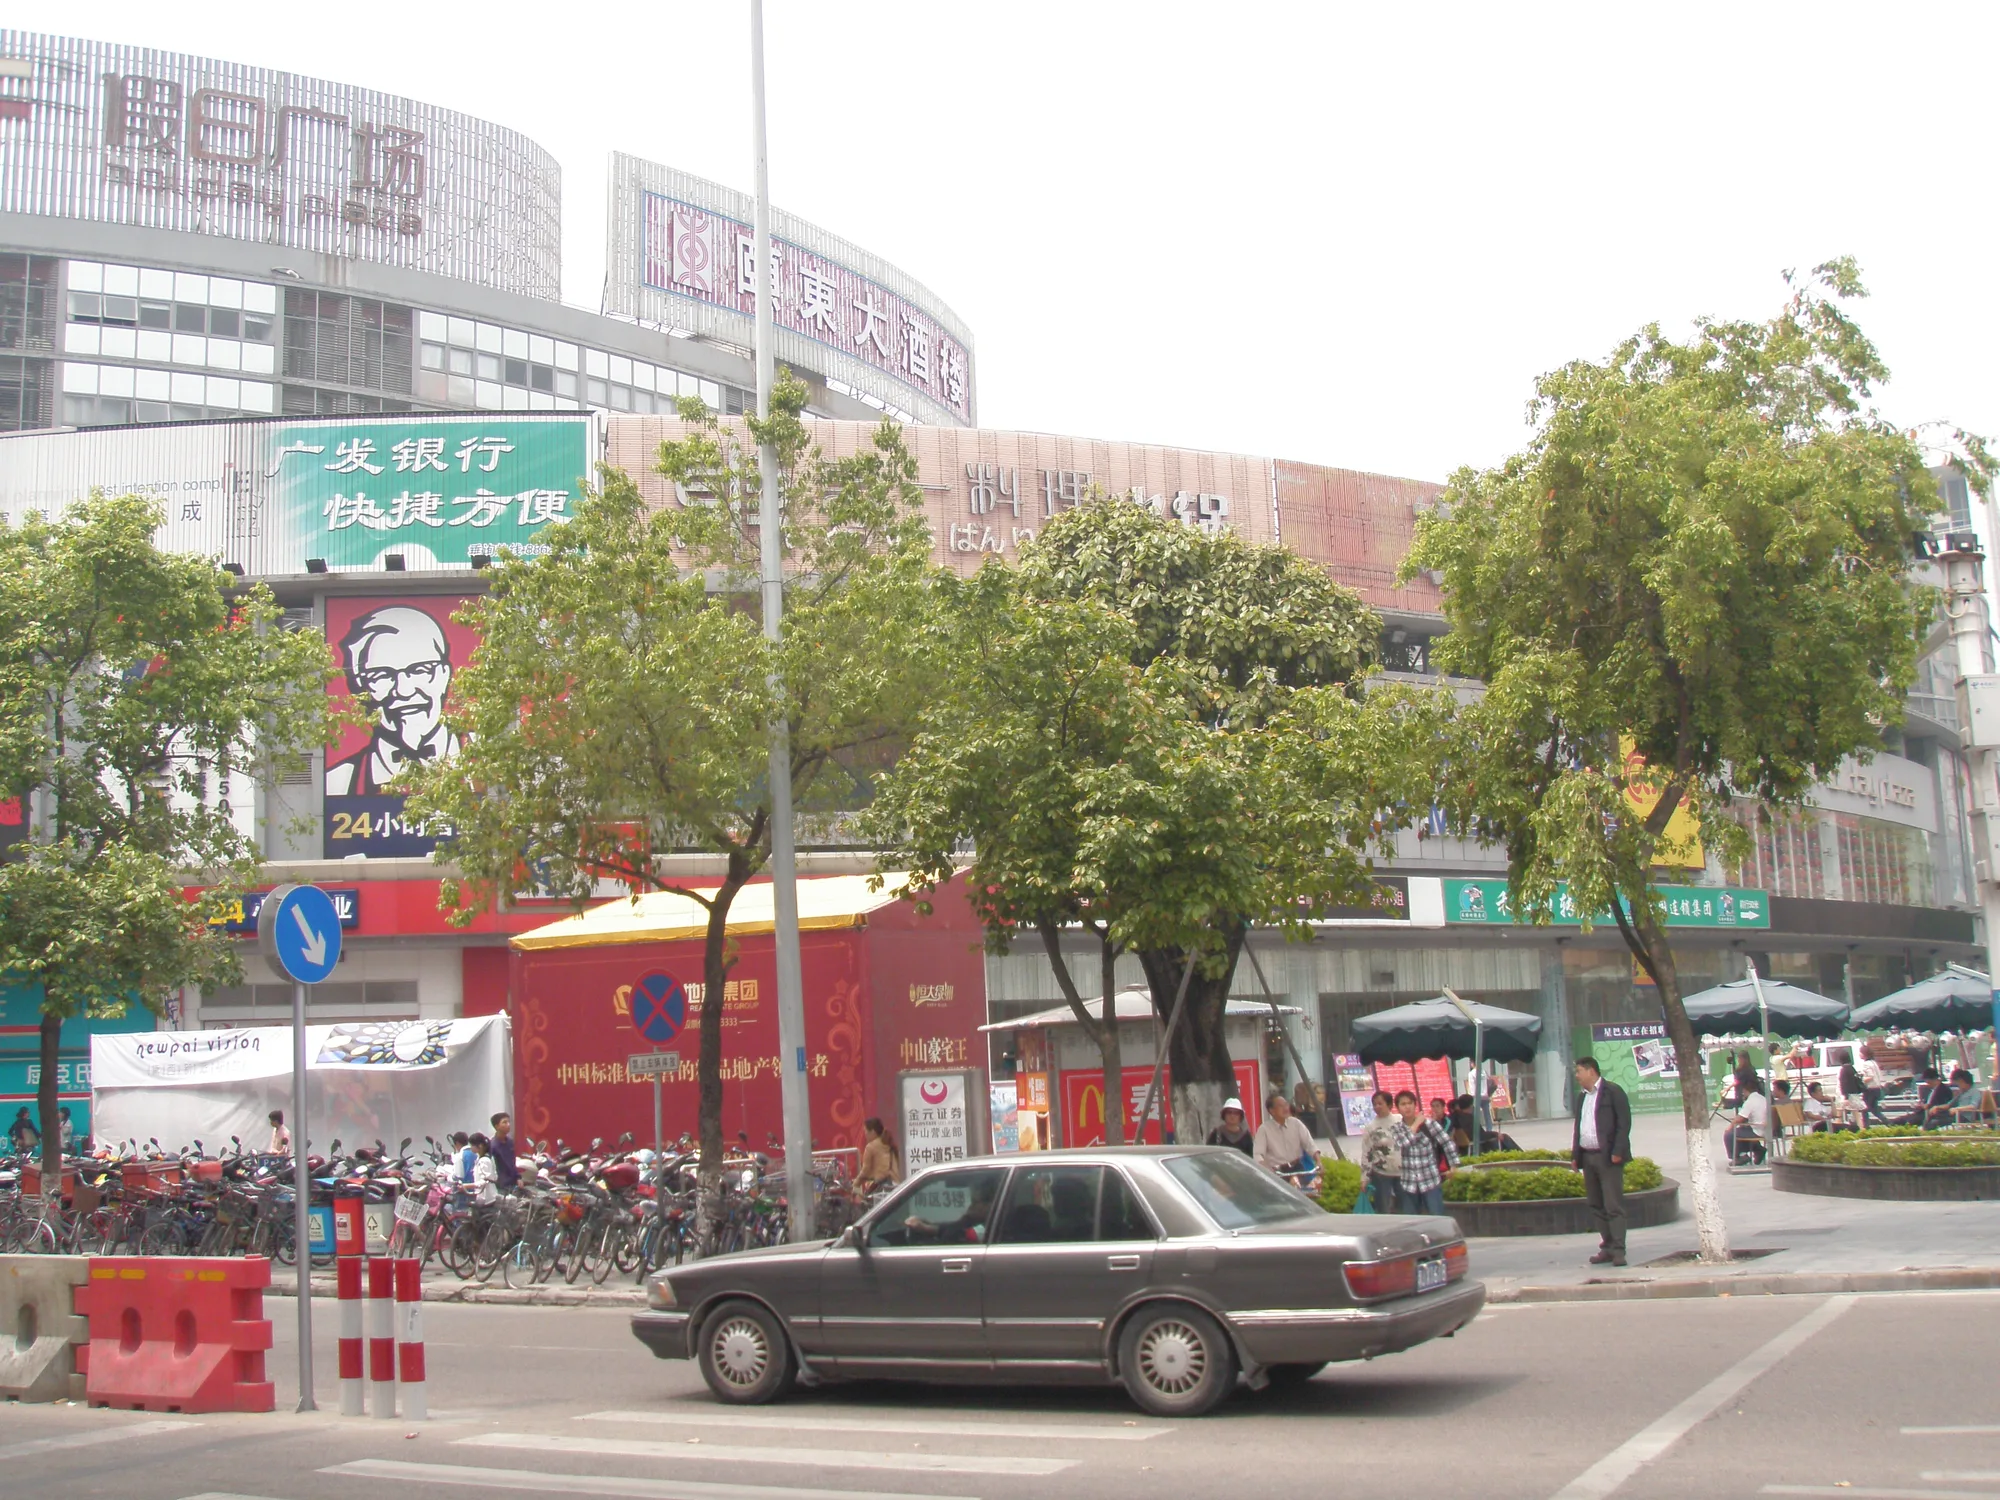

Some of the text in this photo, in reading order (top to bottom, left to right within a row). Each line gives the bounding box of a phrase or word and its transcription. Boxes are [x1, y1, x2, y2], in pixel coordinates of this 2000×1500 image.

[104, 158, 423, 236] holiday plaza
[264, 437, 516, 478] 广发银行
[121, 479, 179, 495] intention
[323, 488, 574, 531] 快捷方便
[136, 1036, 260, 1059] newpai vision
[908, 1107, 962, 1121] 金元证券
[909, 1126, 963, 1139] 中山营业部
[910, 1146, 963, 1163] 兴中道5号
